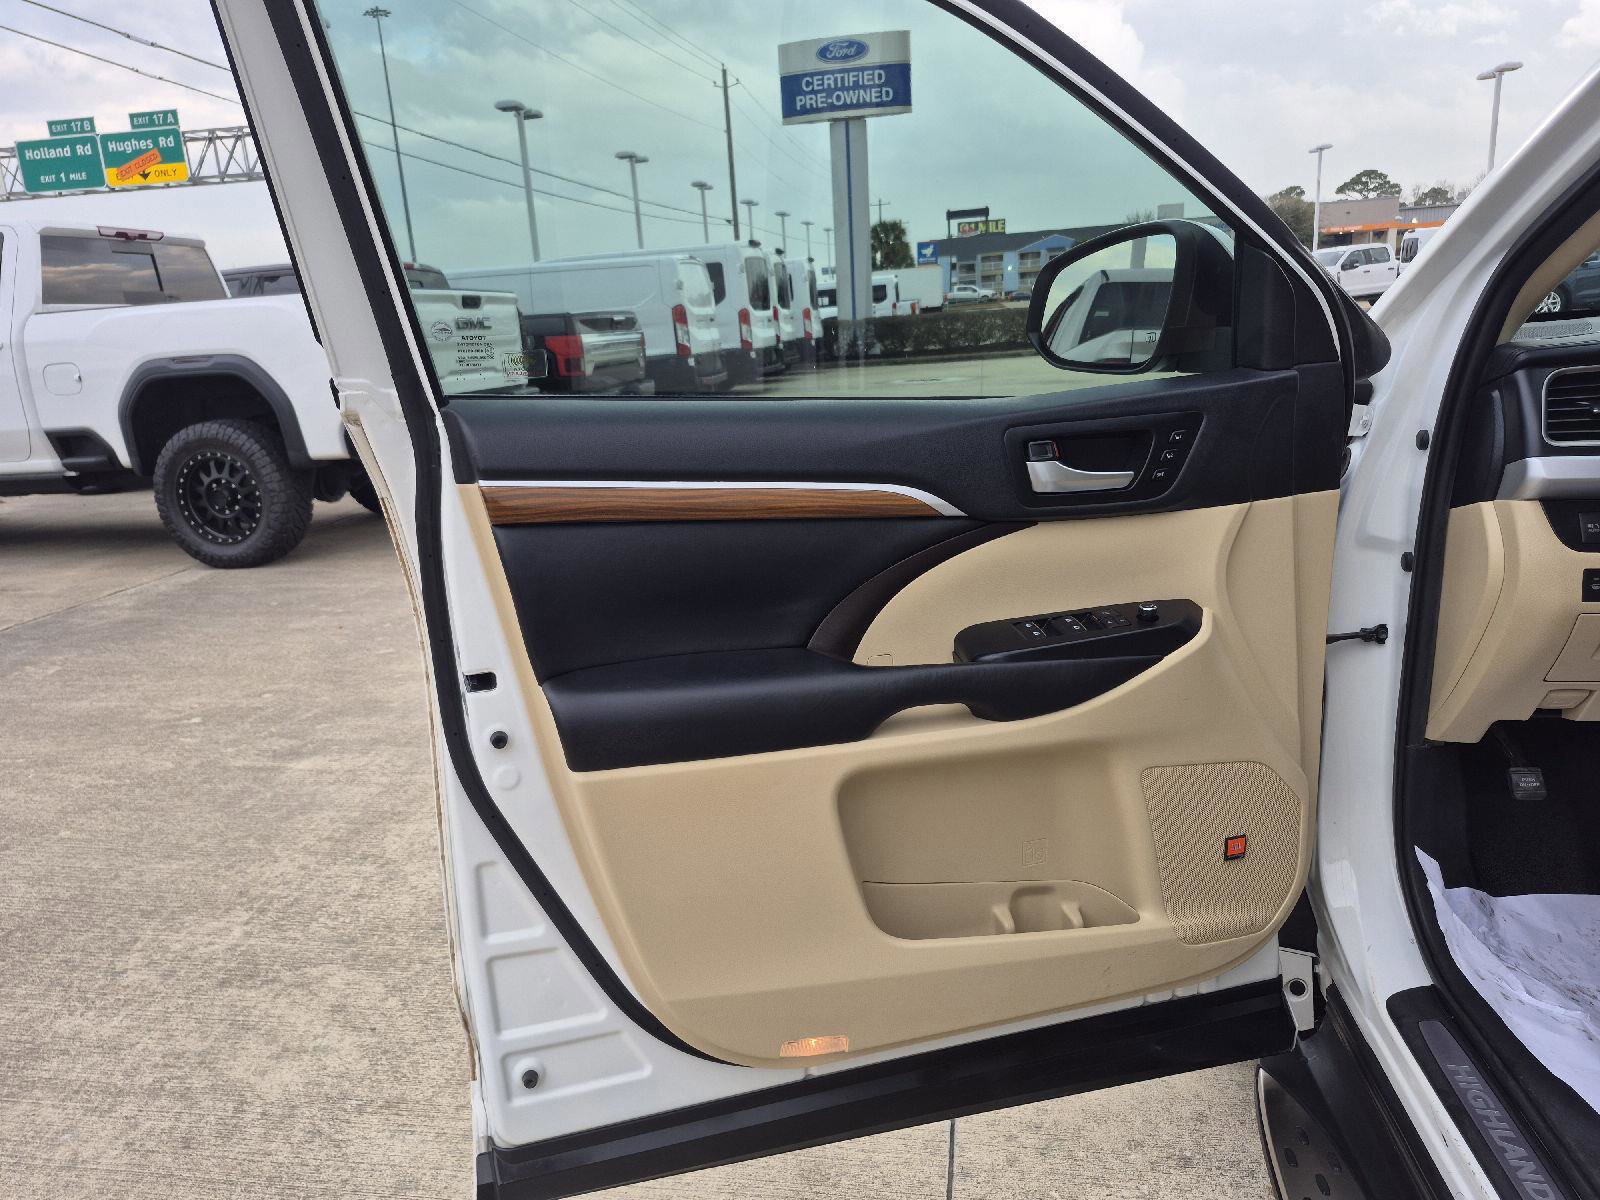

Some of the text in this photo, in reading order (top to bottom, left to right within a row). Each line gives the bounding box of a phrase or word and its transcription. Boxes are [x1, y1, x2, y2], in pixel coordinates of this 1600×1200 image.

[826, 41, 857, 58] Ford
[801, 69, 886, 91] CERTIFIED
[795, 87, 894, 111] PRE-OWNED
[51, 120, 91, 132] EXIT 17 B
[133, 112, 175, 125] EXIT 17 A
[24, 143, 92, 160] Holland Rd
[107, 135, 175, 153] Hughes Rd
[134, 153, 158, 169] CLOSED
[40, 172, 87, 183] EXIT 1 MILE
[154, 168, 177, 177] ONLY
[455, 317, 493, 330] GMC
